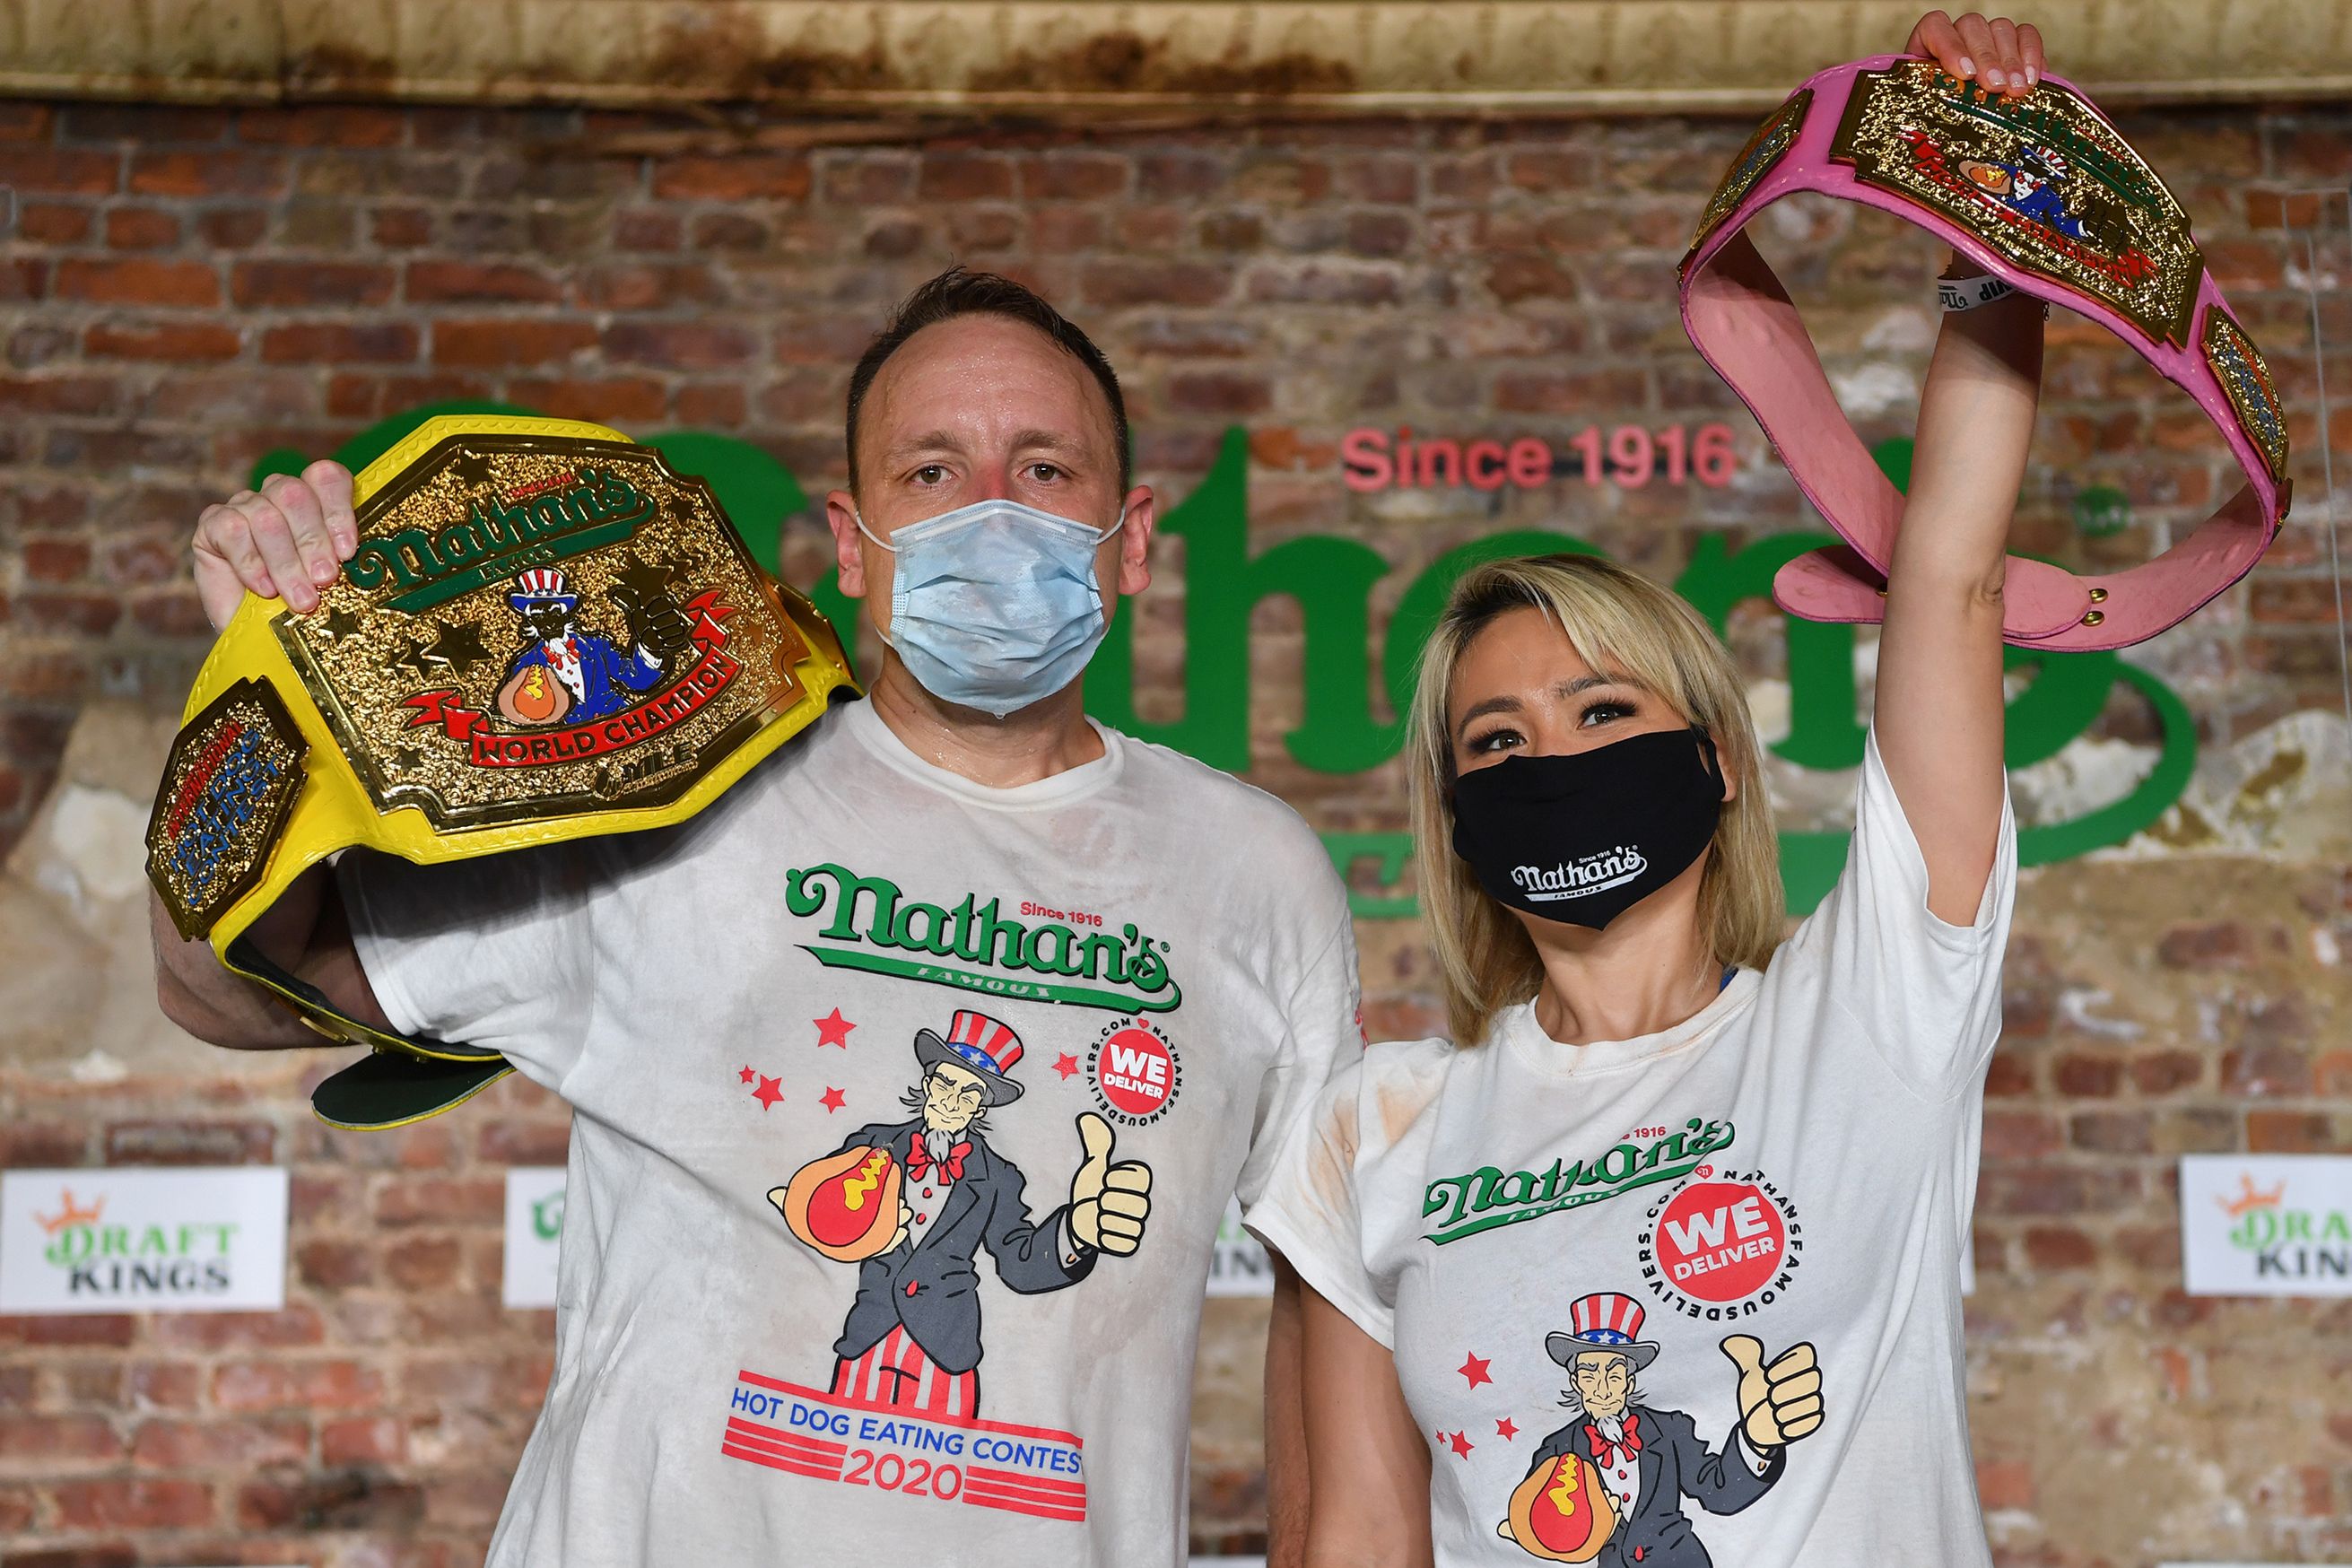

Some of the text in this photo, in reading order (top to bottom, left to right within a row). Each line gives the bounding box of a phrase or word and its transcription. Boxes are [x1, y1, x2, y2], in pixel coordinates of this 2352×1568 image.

[1342, 422, 1737, 492] Since 1916
[344, 467, 640, 589] Nathan's
[478, 653, 734, 763] WORLD CHAMPION
[170, 799, 209, 874] HOT
[210, 728, 260, 802] DOG
[1511, 845, 1642, 892] Nathan's
[1578, 849, 1612, 865] Since 1916
[1020, 901, 1102, 927] Since 1916
[1554, 885, 1603, 899] FAMOUS
[785, 862, 1169, 993] Nathan's
[916, 966, 1053, 998] FAMOUS
[1103, 1072, 1163, 1101] DELIVER
[1110, 1043, 1168, 1084] WE
[1633, 1126, 1666, 1137] 1916
[45, 1223, 240, 1267] DRAFT
[1664, 1195, 1771, 1257] WE
[69, 1258, 231, 1294] KINGS
[1672, 1234, 1777, 1282] DELIVER
[731, 1387, 1085, 1476] HOT DOG EATING CONTES
[843, 1449, 963, 1501] 2020
